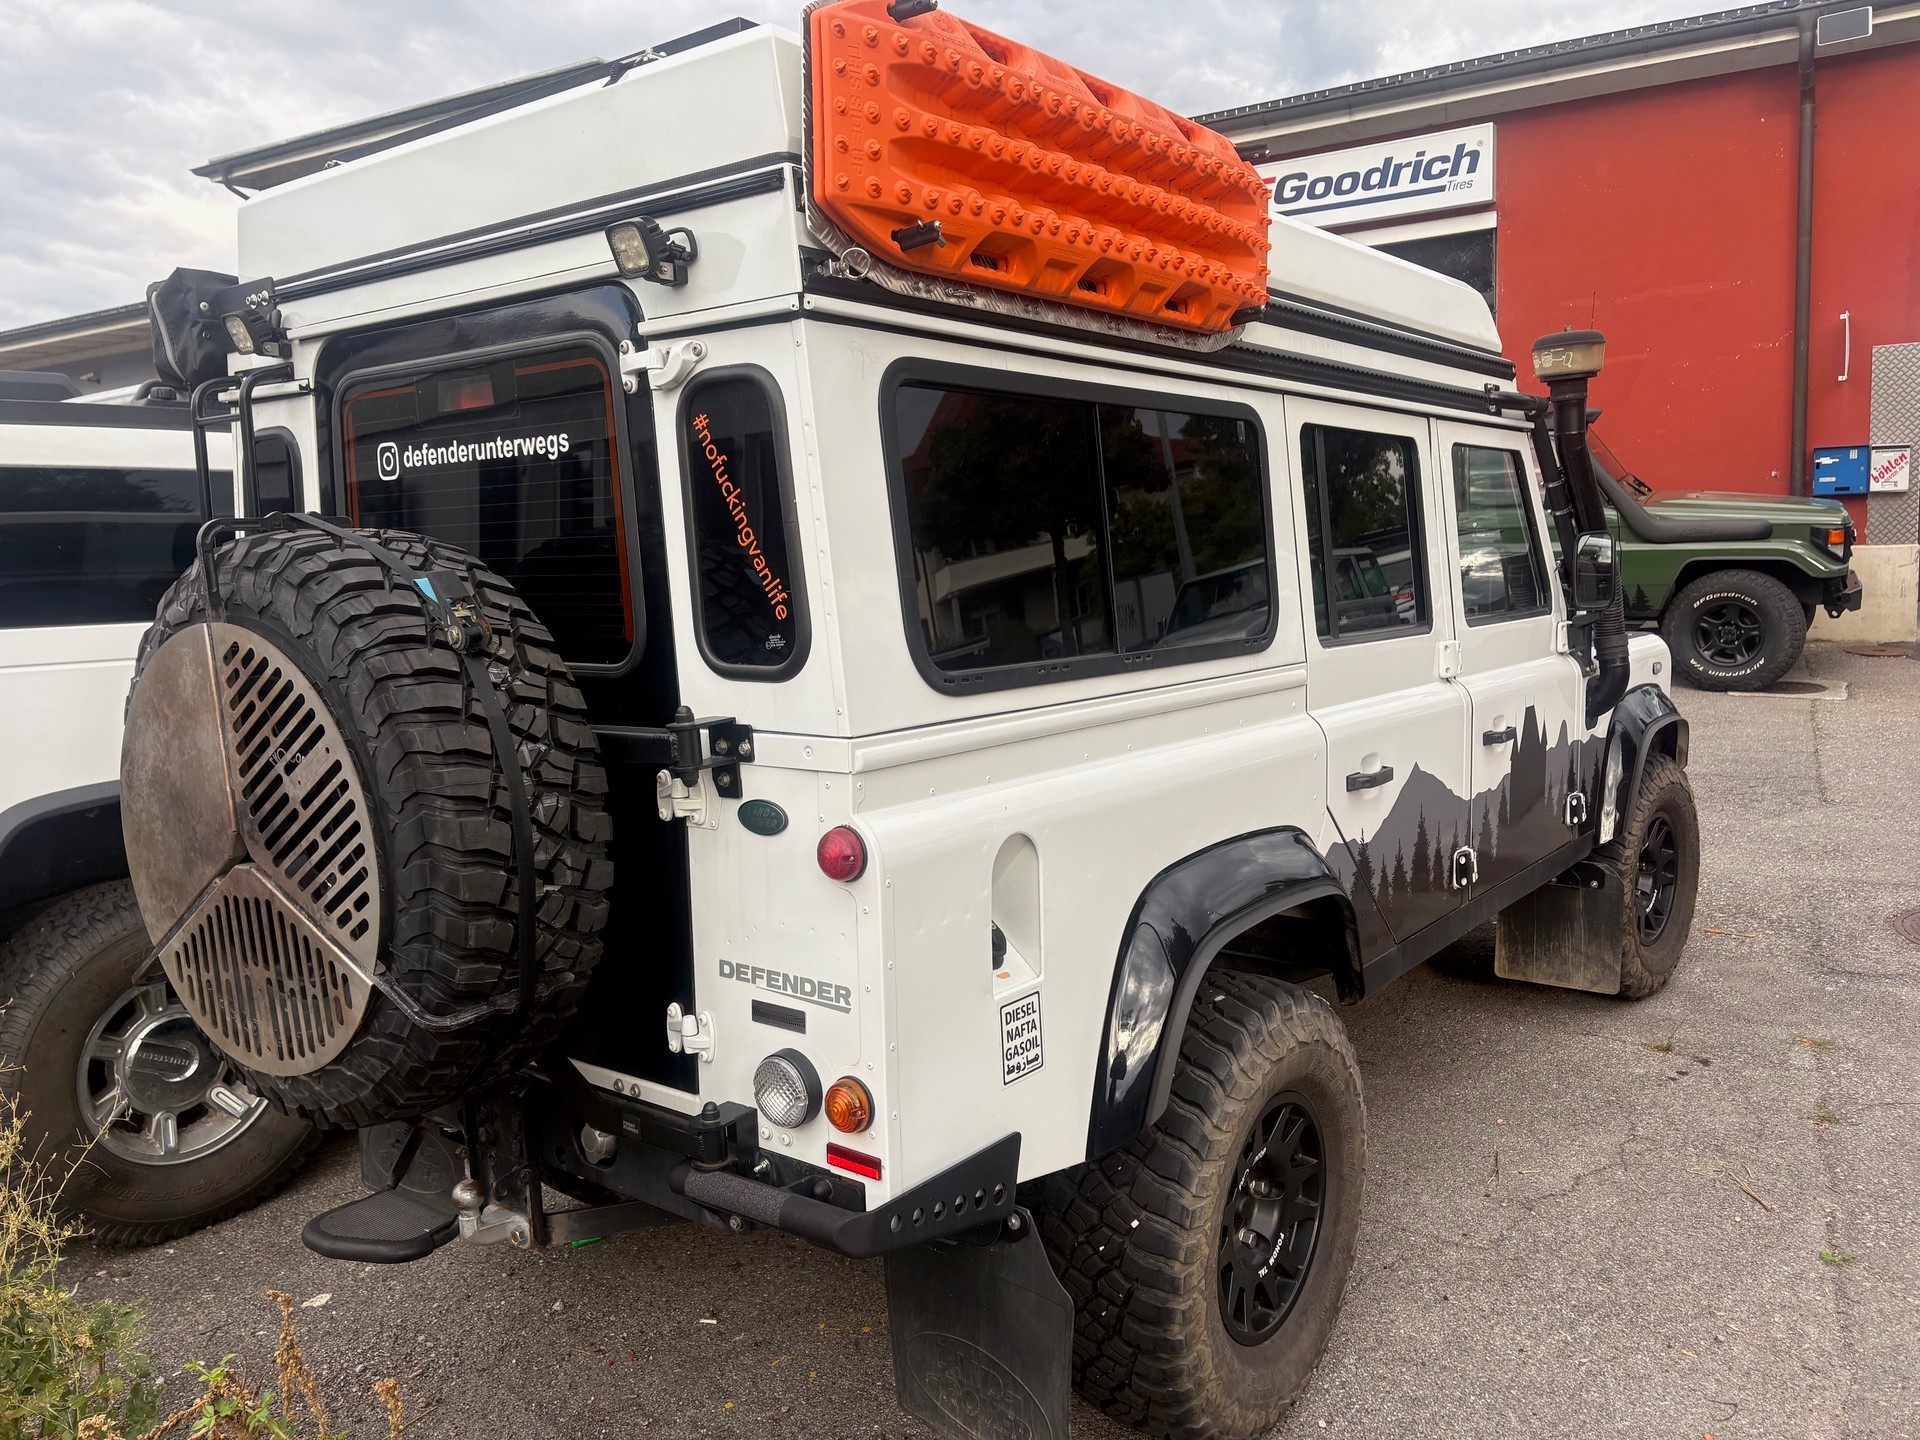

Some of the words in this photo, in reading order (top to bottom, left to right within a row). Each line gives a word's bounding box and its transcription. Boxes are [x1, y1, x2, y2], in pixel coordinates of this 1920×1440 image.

[1446, 179, 1474, 192] Tires
[402, 430, 570, 469] defenderunterwegs
[1871, 453, 1907, 483] böhlen
[692, 413, 789, 621] #nofuckingvanlife
[1693, 592, 1758, 609] BFGoodrich
[748, 806, 771, 817] LAND
[719, 959, 852, 1008] DEFENDER
[1005, 1001, 1037, 1026] DIESEL
[1006, 1018, 1037, 1043] NAFTA
[1005, 1035, 1040, 1061] GASOIL
